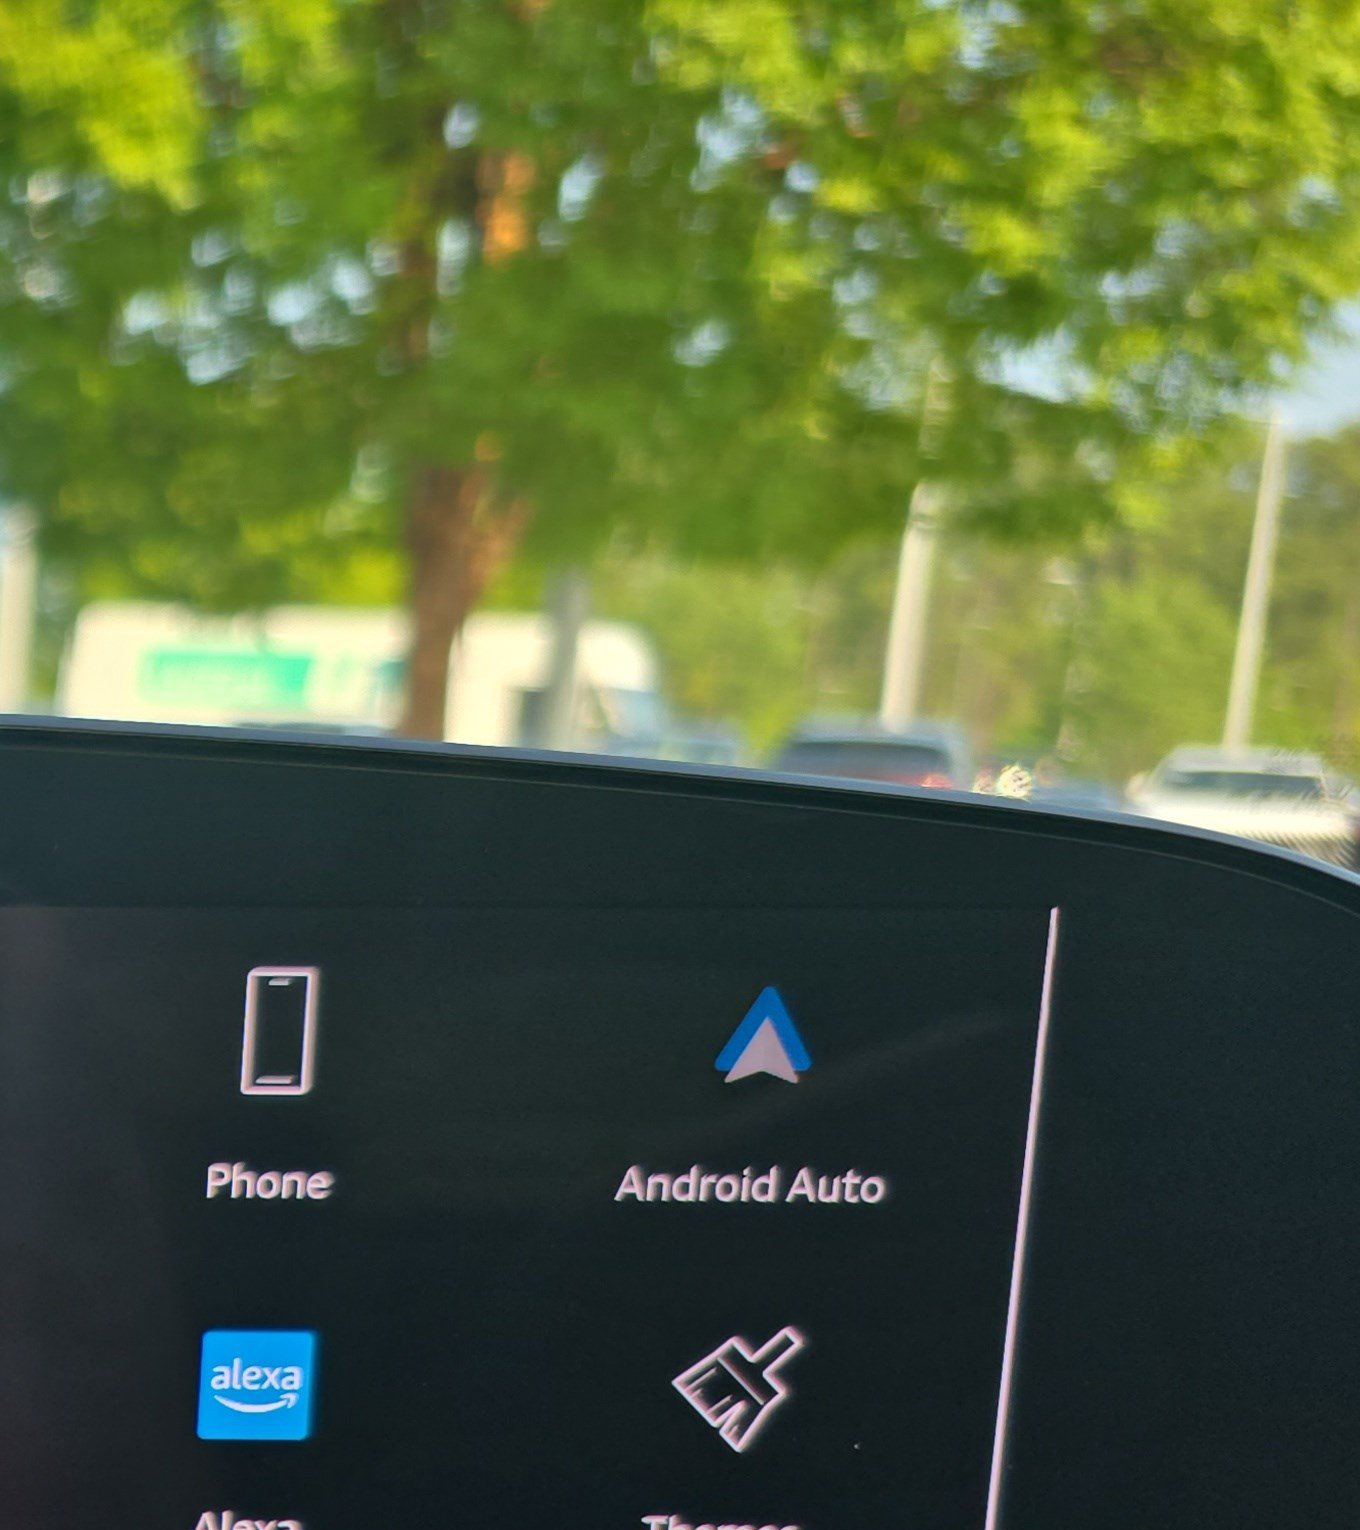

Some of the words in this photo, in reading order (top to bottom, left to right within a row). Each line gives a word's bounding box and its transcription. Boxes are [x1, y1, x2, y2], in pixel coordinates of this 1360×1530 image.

[206, 1162, 334, 1200] Phone
[613, 1164, 780, 1203] Android
[784, 1166, 886, 1204] Auto
[210, 1357, 302, 1390] alexa
